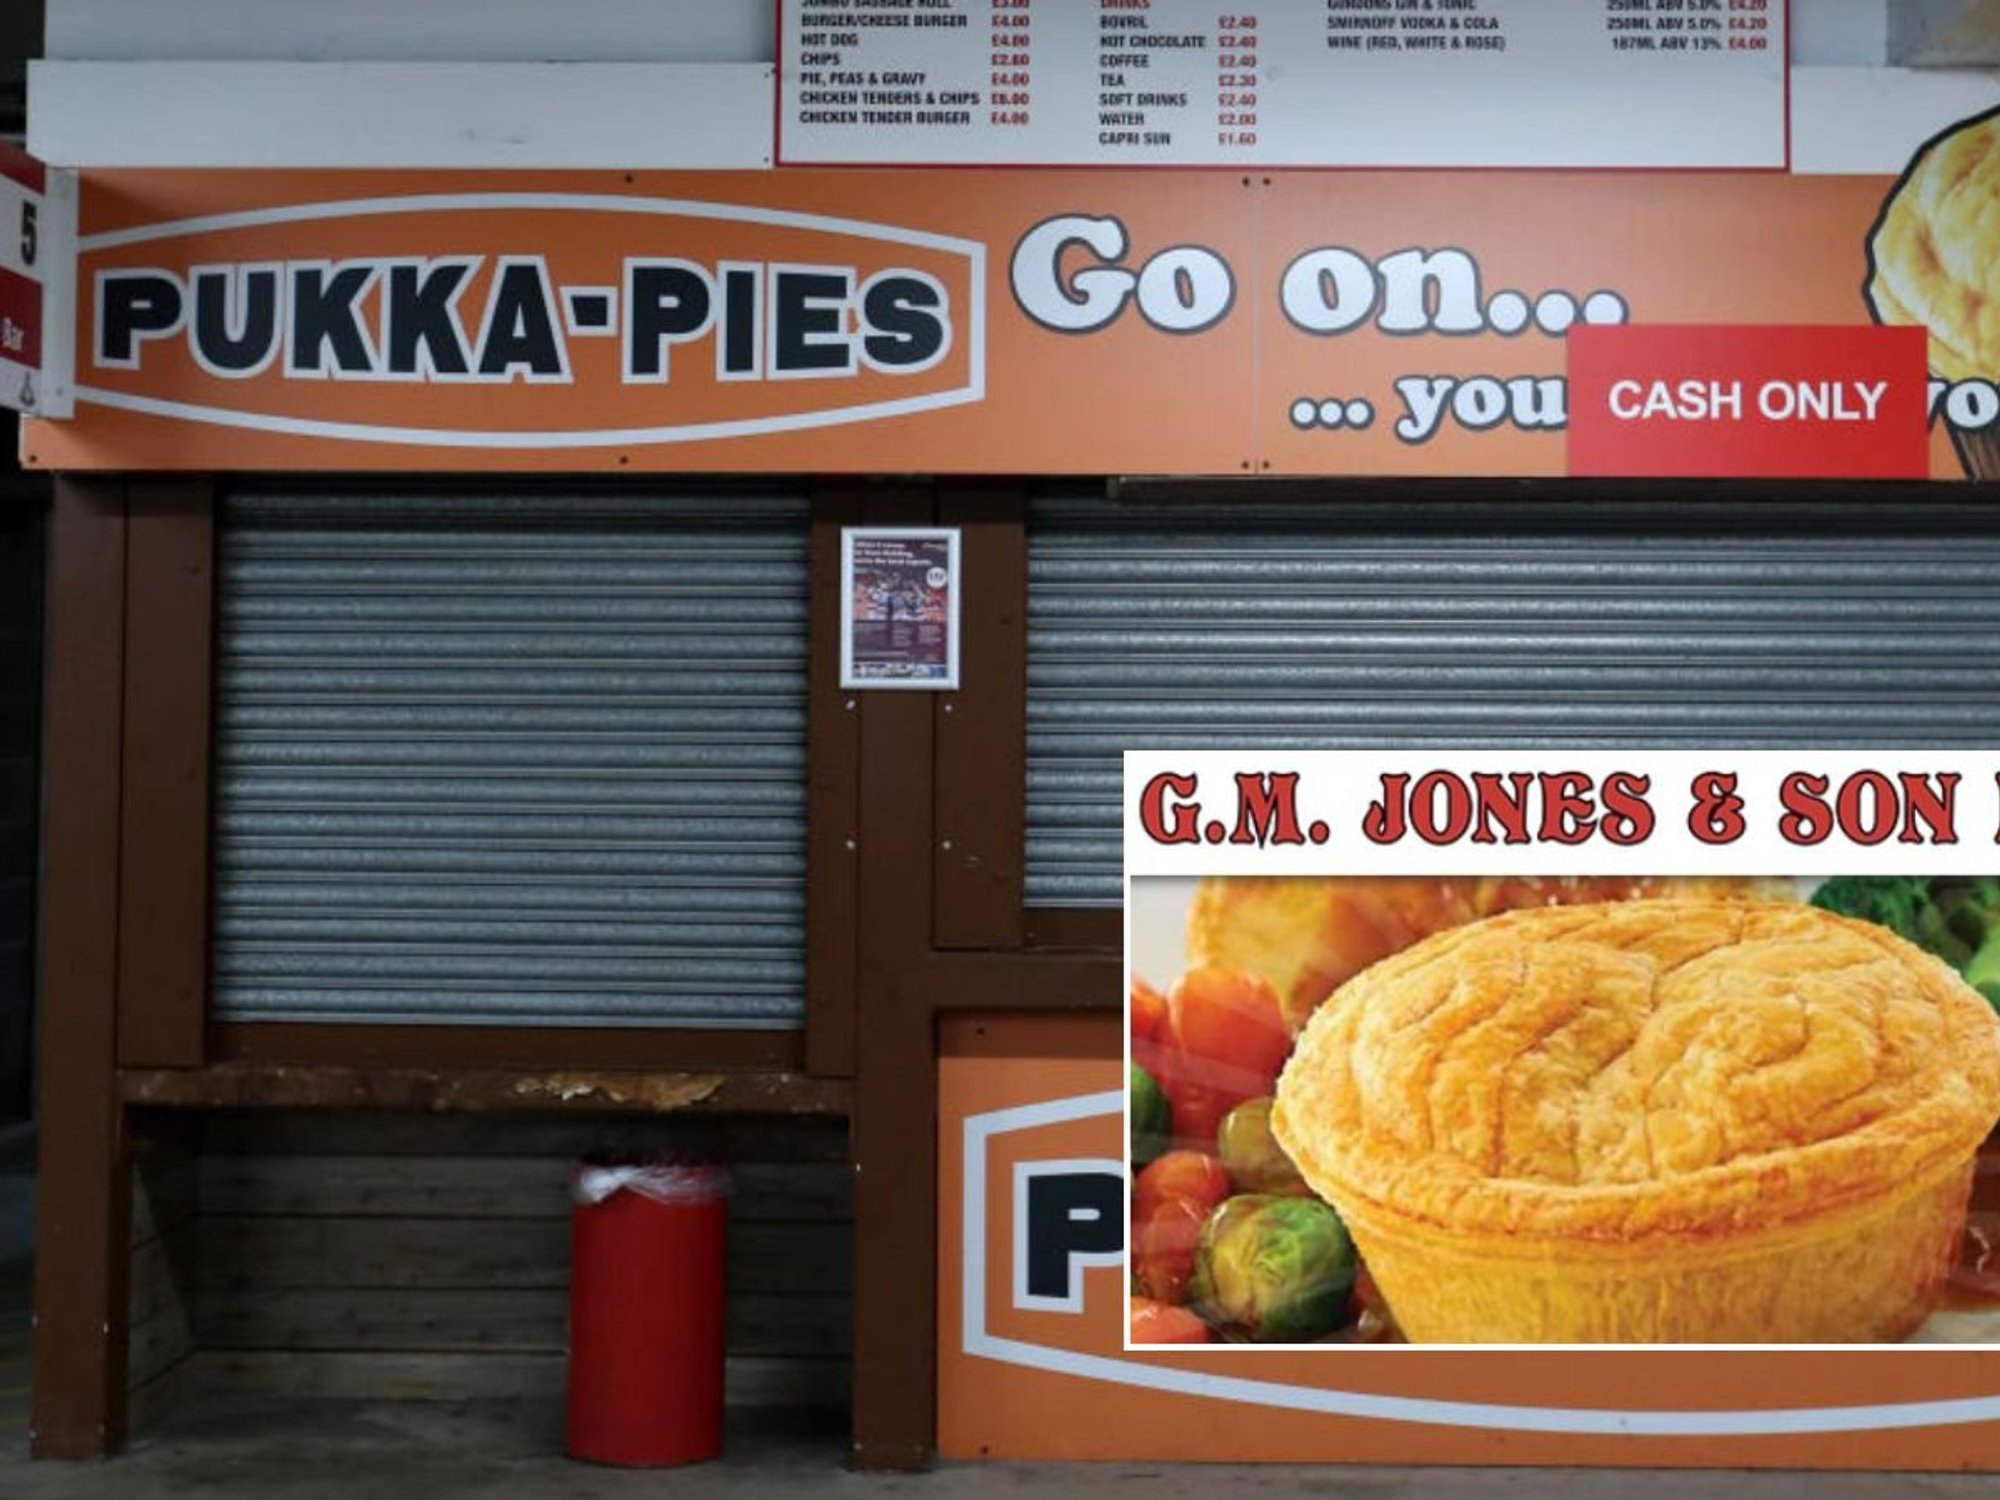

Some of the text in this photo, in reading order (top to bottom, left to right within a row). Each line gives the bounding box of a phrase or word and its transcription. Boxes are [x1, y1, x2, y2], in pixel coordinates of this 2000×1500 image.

[914, 15, 967, 27] BURGER
[1401, 16, 1446, 29] VODKA
[1463, 17, 1499, 29] COLA
[1656, 17, 1685, 30] ABV
[801, 34, 826, 46] HOT
[831, 34, 858, 46] DOG
[1100, 35, 1125, 48] HOT
[1130, 35, 1206, 48] CHOCOLATE
[1328, 36, 1361, 49] WINE
[1405, 36, 1446, 49] WHITE
[1661, 37, 1689, 50] ABV
[801, 53, 840, 65] CHIPS
[1100, 54, 1149, 67] COFFEE
[801, 73, 826, 86] PIE,
[830, 73, 864, 85] PEAS
[867, 73, 878, 85] &
[882, 73, 926, 86] GRAVY
[1101, 74, 1125, 87] TEA
[801, 92, 857, 104] CHICKEN
[862, 92, 922, 104] TENDERS
[925, 92, 936, 104] &
[940, 92, 980, 104] CHIPS
[1099, 94, 1132, 106] SOFT
[1137, 94, 1188, 107] DRINKS
[800, 112, 857, 124] CHICKEN
[862, 112, 912, 124] TENDER
[917, 112, 970, 124] BURGER
[1099, 113, 1145, 125] WATER
[1099, 132, 1140, 144] CAPRI
[1143, 133, 1171, 144] SUN
[1009, 213, 1629, 337] Go on...
[93, 255, 953, 385] PUKKA-PIES
[1609, 380, 1888, 422] CASH ONLY
